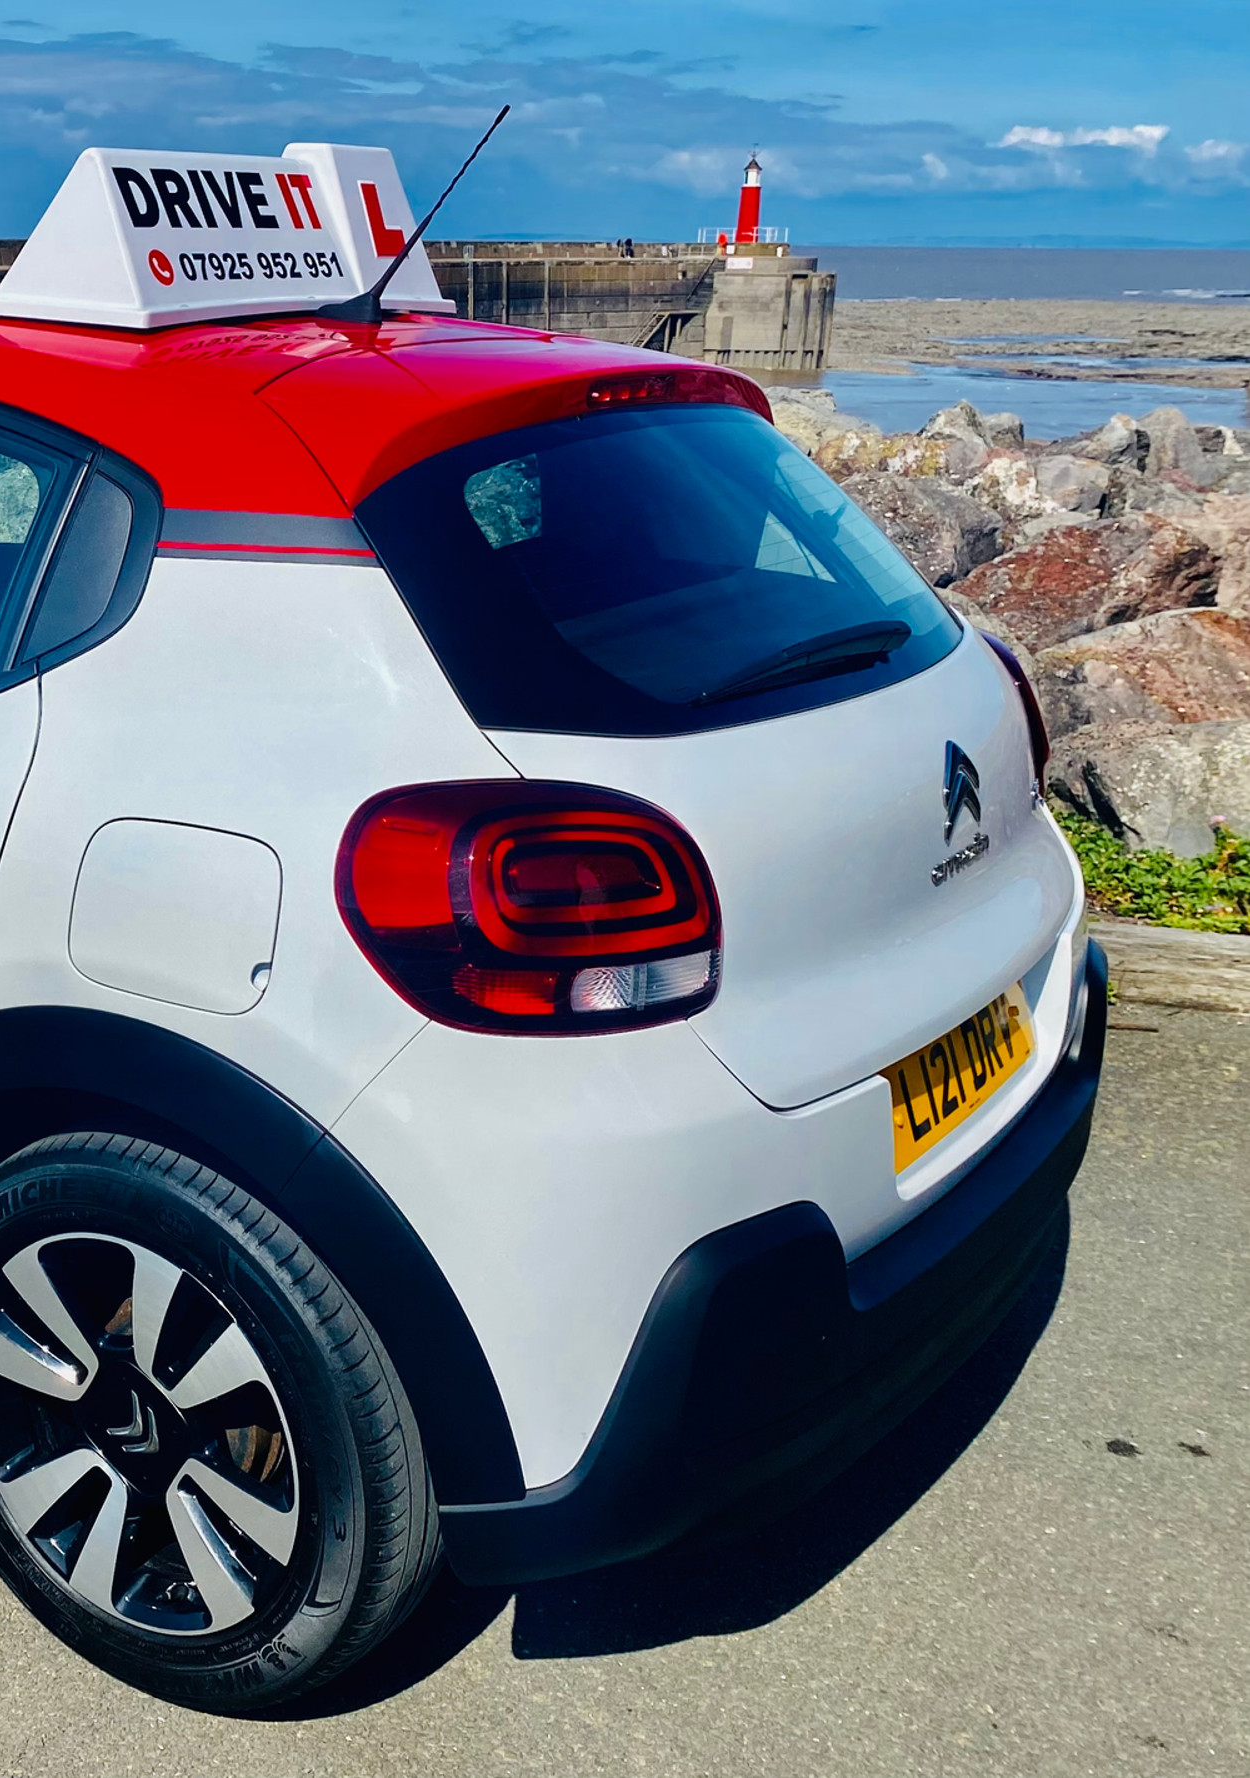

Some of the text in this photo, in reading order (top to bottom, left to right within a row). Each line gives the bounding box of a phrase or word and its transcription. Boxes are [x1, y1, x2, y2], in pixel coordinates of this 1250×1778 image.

[111, 166, 323, 230] DRIVE IT
[359, 182, 407, 258] L
[178, 250, 344, 282] 07925 952 951
